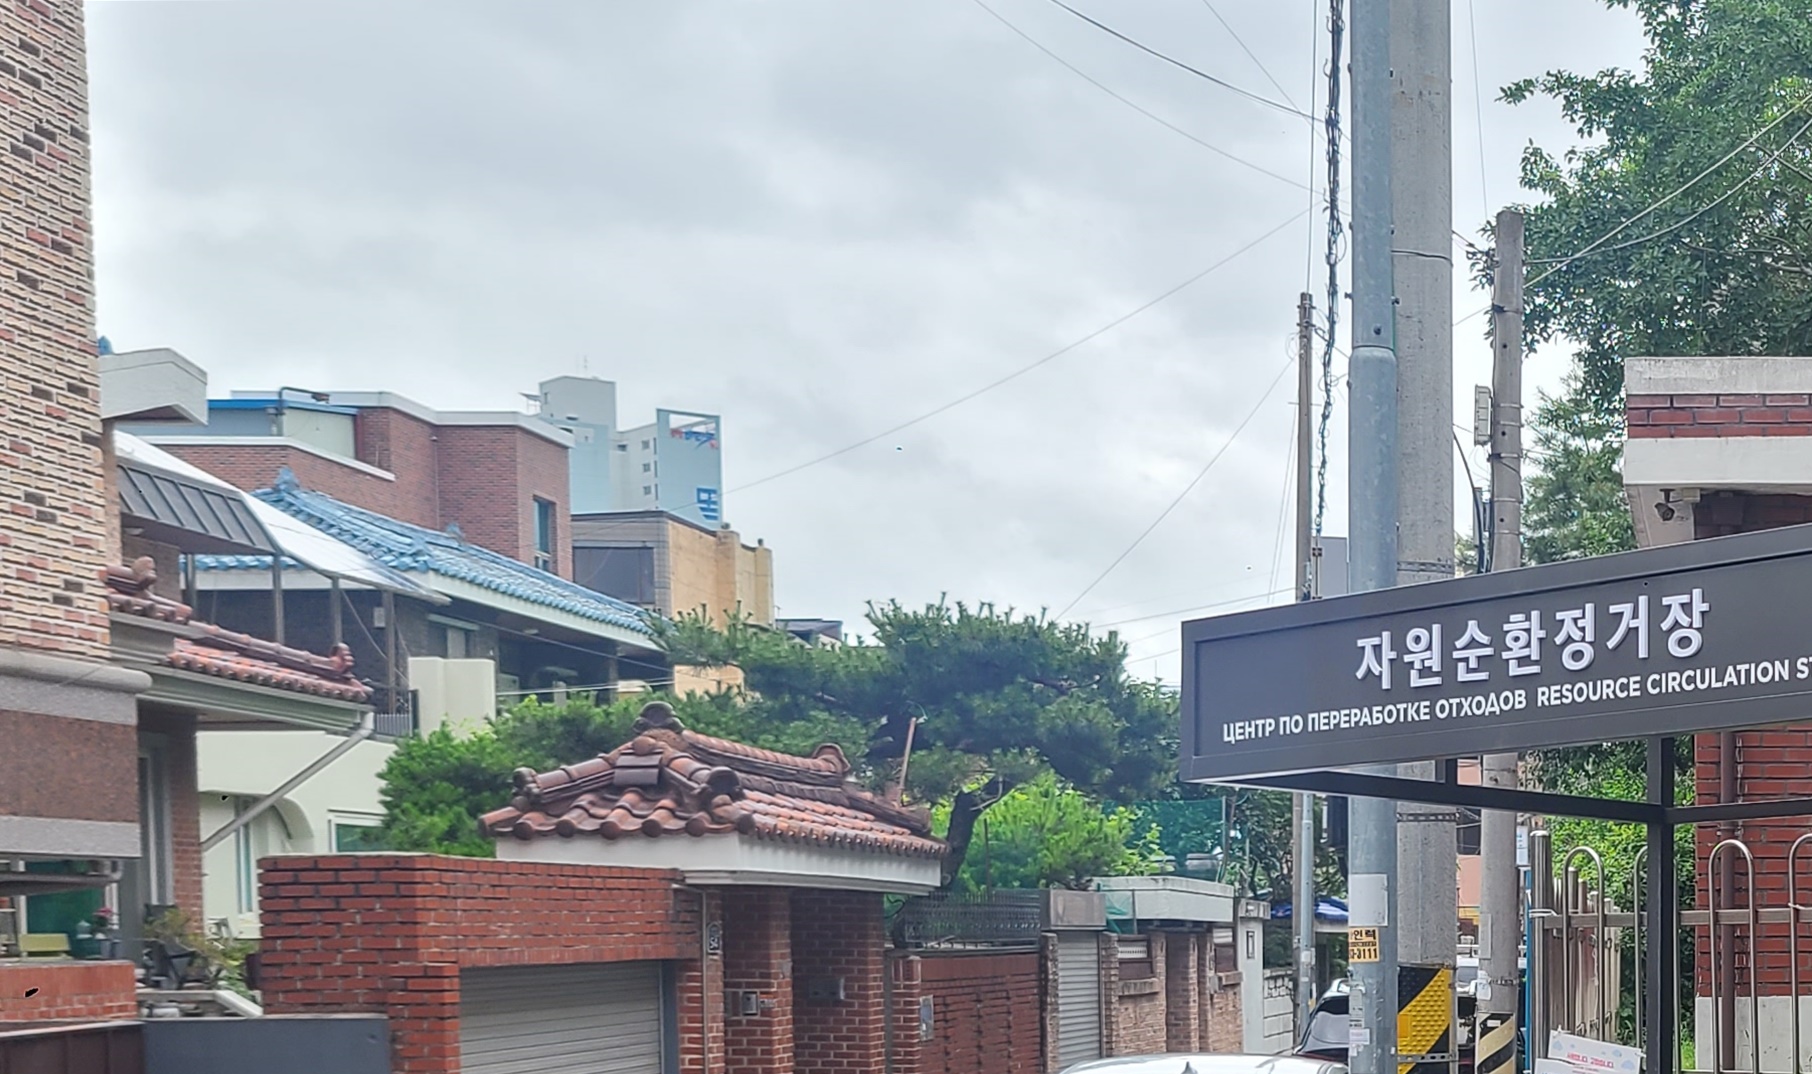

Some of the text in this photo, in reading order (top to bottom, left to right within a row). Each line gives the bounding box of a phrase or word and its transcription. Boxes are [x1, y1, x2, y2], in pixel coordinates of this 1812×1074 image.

[1356, 589, 1710, 690] 자원순환정거장
[1537, 676, 1640, 706] RESOURCE
[1646, 660, 1789, 693] CIRCULATION
[1223, 689, 1526, 743] ЦЕНТР ПО ПЕРЕРАБОТКЕ ОТХОДОВ
[1350, 929, 1376, 940] 인력
